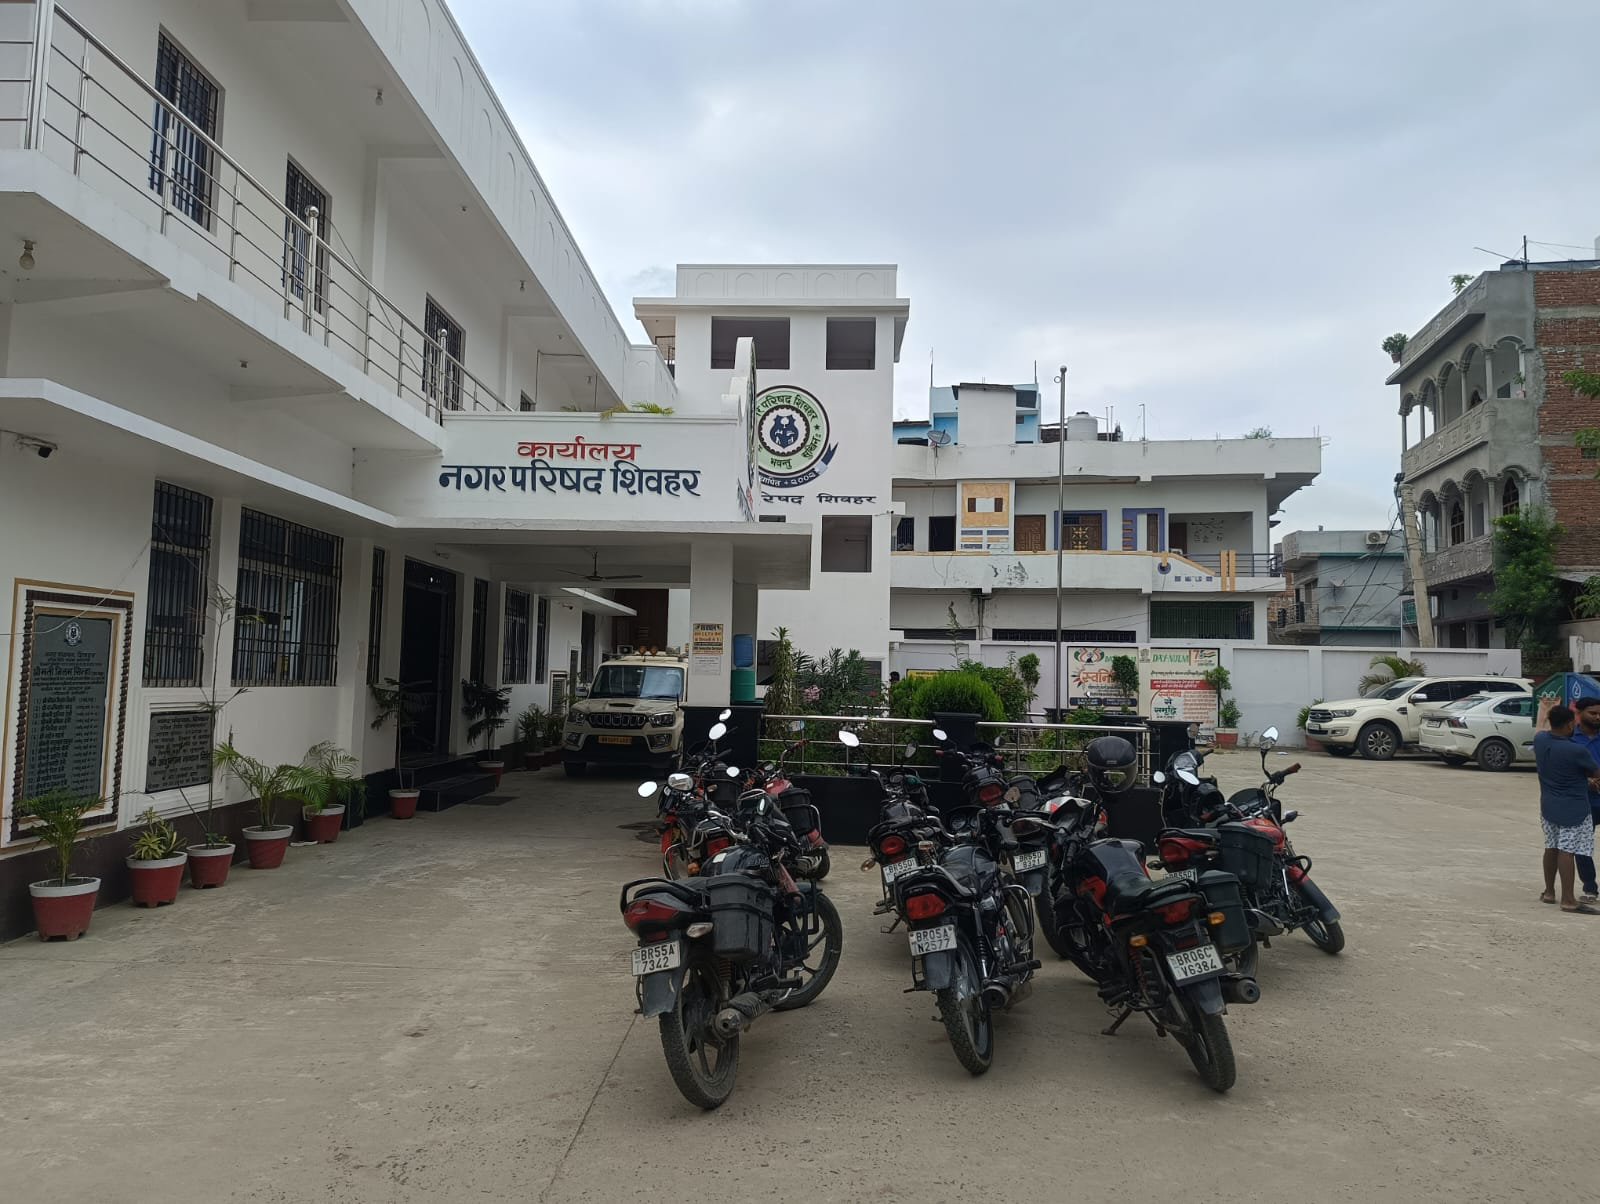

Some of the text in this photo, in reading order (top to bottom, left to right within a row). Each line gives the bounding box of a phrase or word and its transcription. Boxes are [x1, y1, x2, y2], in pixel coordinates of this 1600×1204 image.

[517, 435, 642, 461] कार्यालय
[438, 459, 701, 497] नगर परिषद शिवहर
[816, 492, 877, 505] शिवहर
[915, 928, 949, 943] BR05A
[641, 945, 675, 961] BR55A
[917, 938, 950, 953] N2577
[642, 956, 670, 973] 7342
[1176, 946, 1212, 966] BR06C
[1181, 958, 1217, 977] V6384
